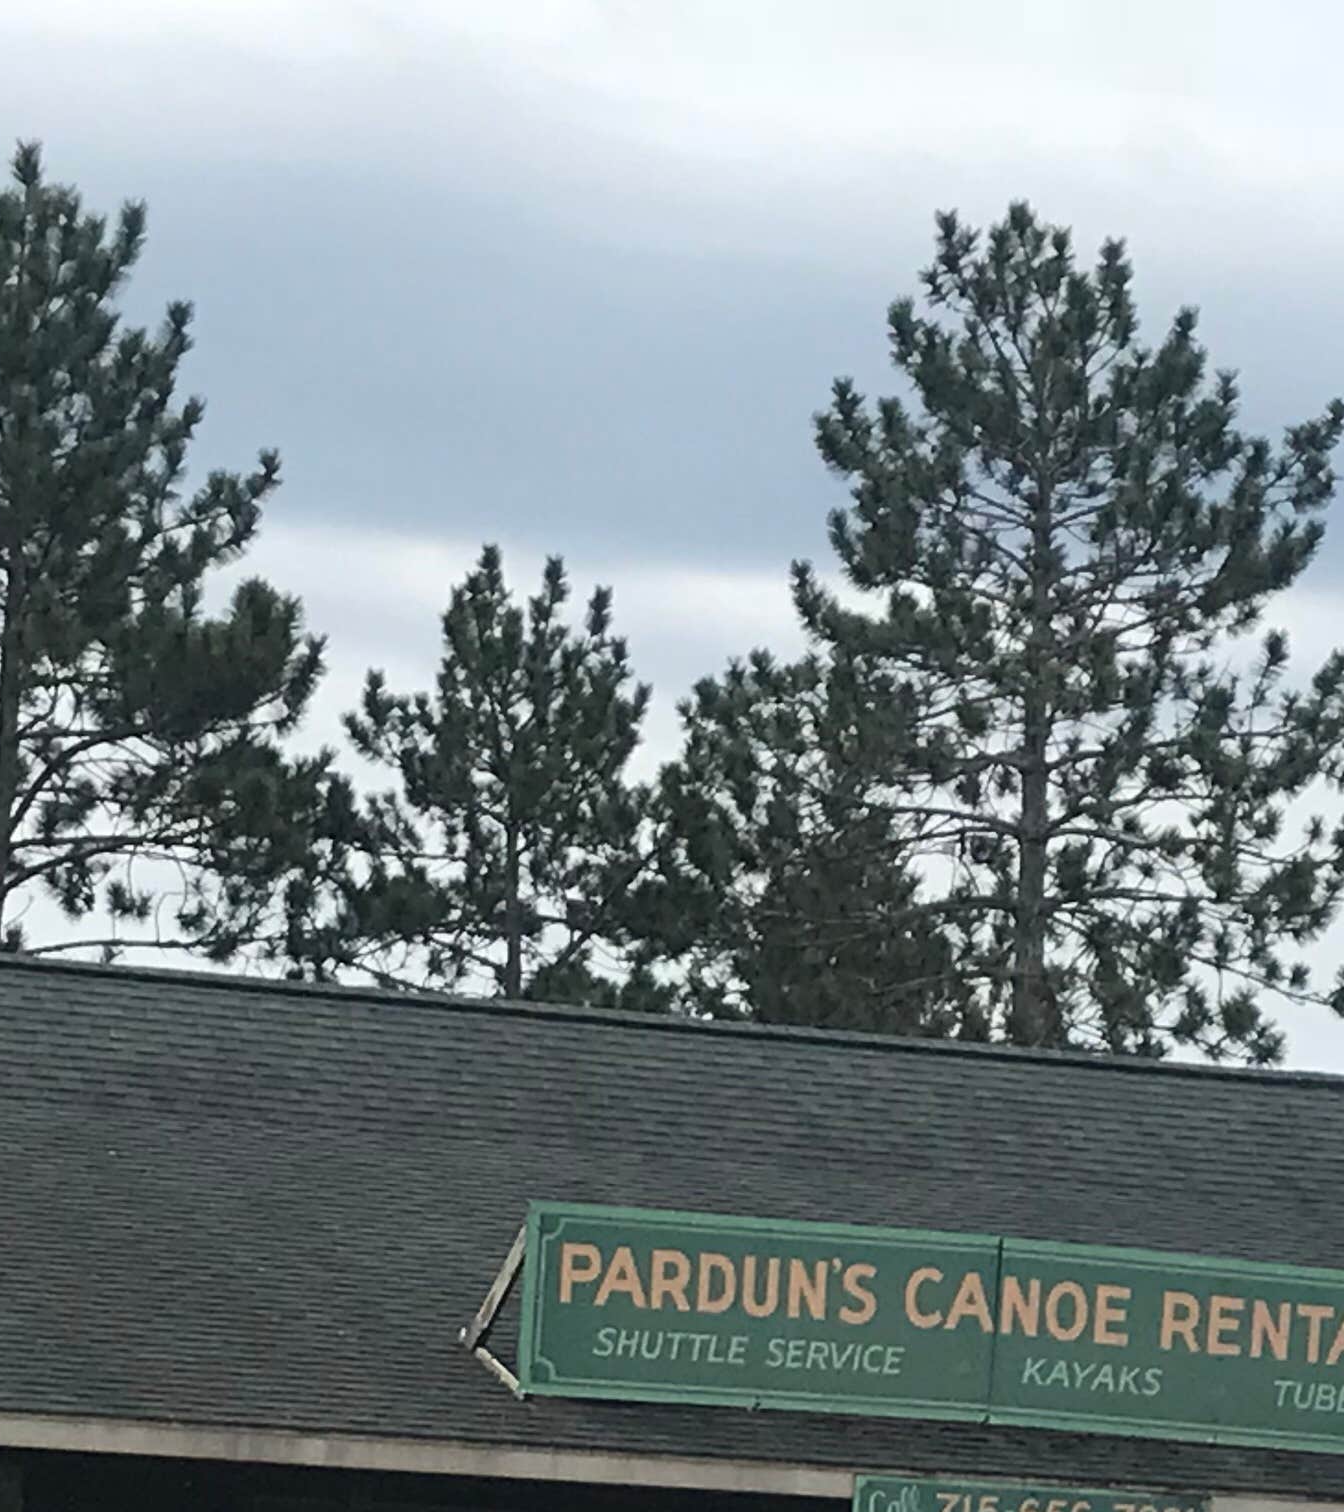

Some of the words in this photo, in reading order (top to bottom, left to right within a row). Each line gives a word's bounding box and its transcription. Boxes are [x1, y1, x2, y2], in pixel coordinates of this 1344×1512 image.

[559, 1242, 877, 1325] PARDUN'S
[905, 1266, 1132, 1347] CANOE
[592, 1327, 749, 1364] SHUTTLE
[765, 1337, 906, 1375] SERVICE
[1021, 1356, 1164, 1397] KAYAKS
